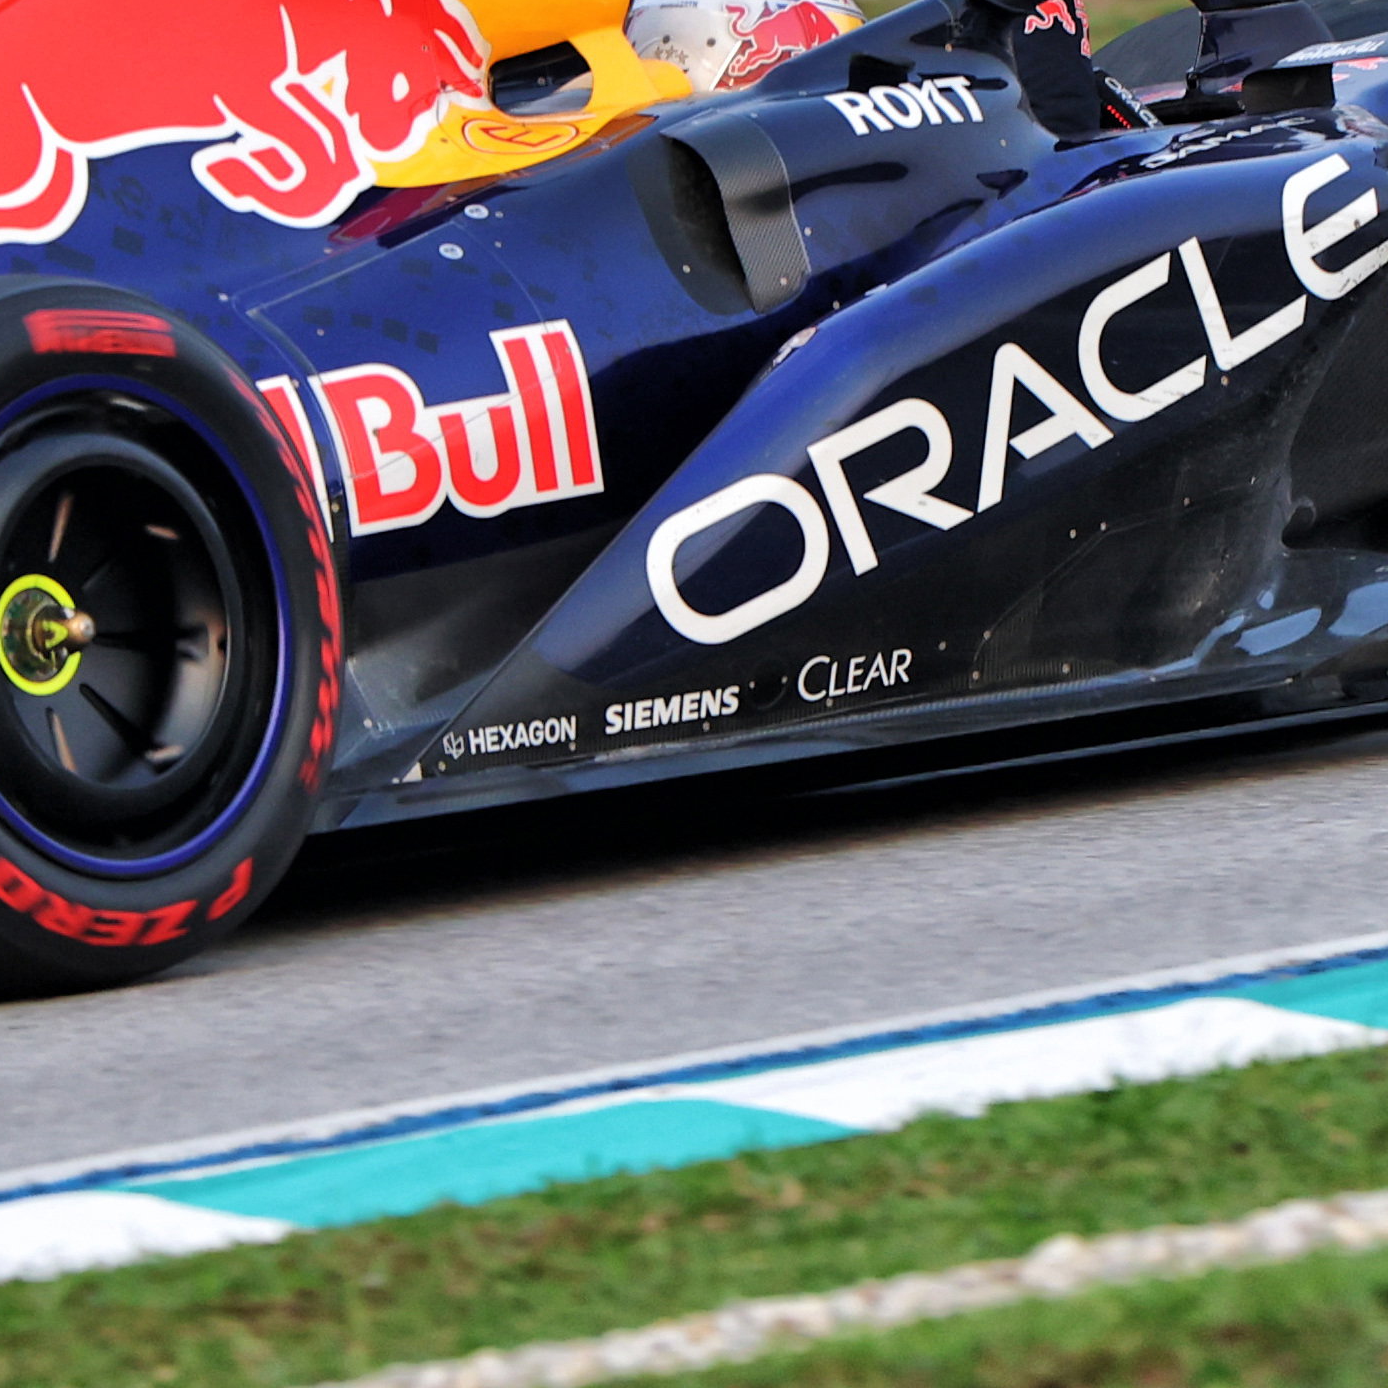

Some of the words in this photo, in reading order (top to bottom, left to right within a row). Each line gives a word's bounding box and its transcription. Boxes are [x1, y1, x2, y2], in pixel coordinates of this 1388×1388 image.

[309, 320, 604, 537] Bull
[797, 648, 912, 703] CLEAR
[469, 716, 577, 756] HEXAGON
[605, 685, 740, 735] SIEMENS
